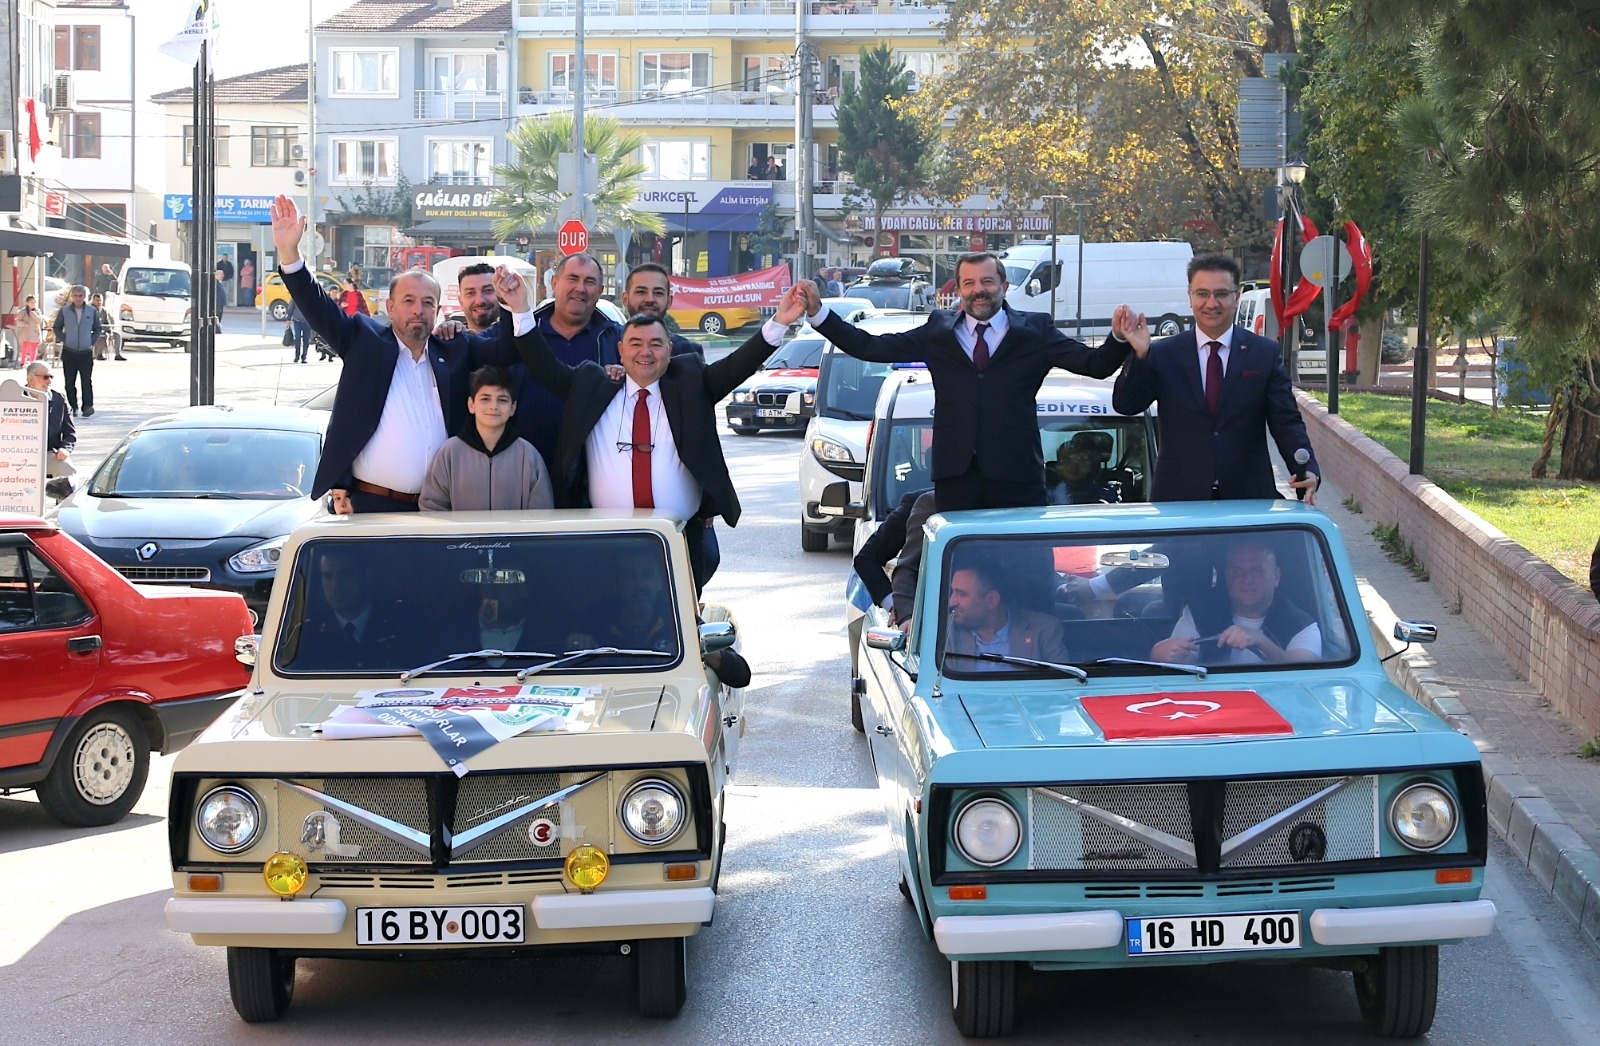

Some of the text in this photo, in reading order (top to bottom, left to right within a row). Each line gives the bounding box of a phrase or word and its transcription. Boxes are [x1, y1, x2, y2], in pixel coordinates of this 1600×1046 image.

[239, 199, 273, 209] TARIM
[415, 189, 471, 210] ÇAĞLAR
[720, 196, 769, 206] ALİM İLETİŞİM
[864, 216, 907, 230] MYDAN
[966, 217, 974, 230] &
[1017, 217, 1053, 231] SALON
[561, 232, 586, 247] DUR
[704, 294, 734, 305] KUTLU
[734, 293, 762, 303] OLSUN
[768, 409, 783, 417] ATM
[1036, 402, 1108, 415] EDİYESİ
[0, 446, 39, 454] DOĞALGAZ
[0, 475, 37, 484] odafone
[364, 909, 521, 942] 16 BY 003
[1146, 917, 1295, 950] 16 HD 400
[1129, 939, 1142, 947] TR
